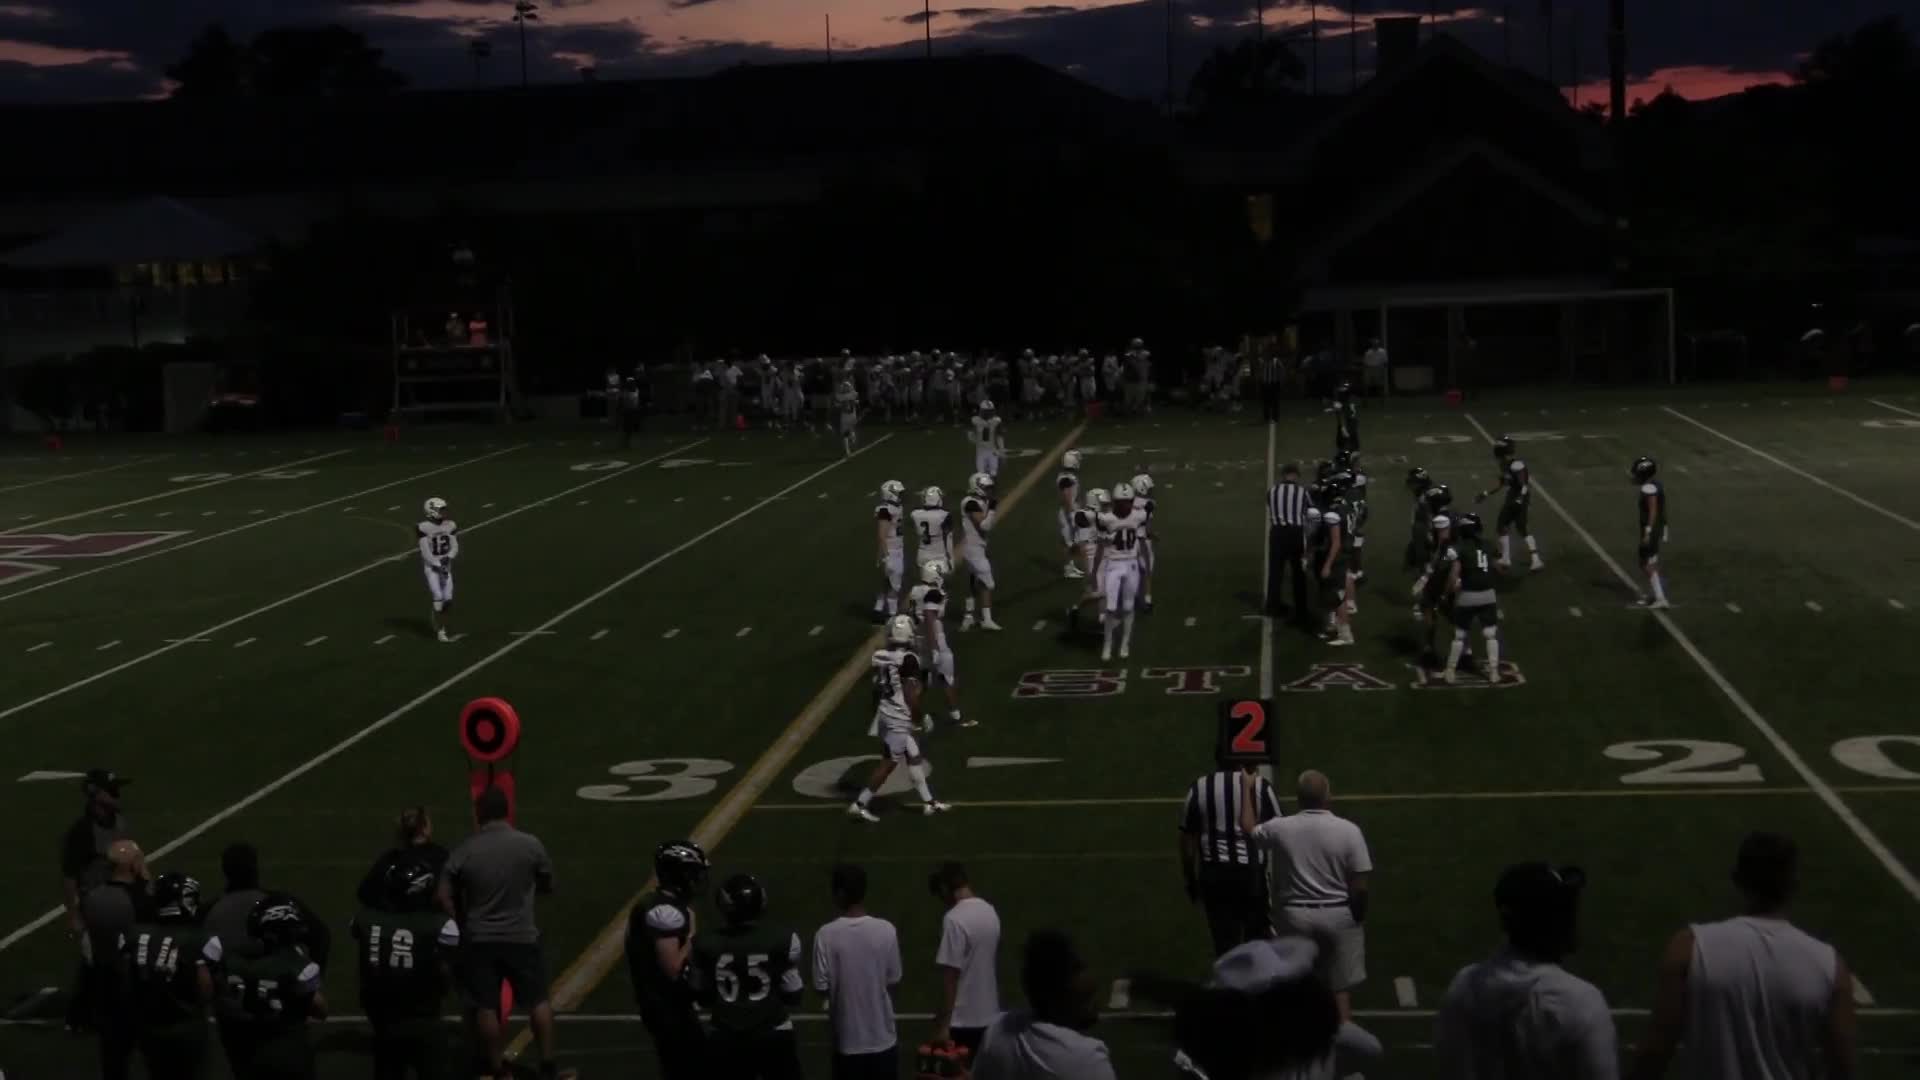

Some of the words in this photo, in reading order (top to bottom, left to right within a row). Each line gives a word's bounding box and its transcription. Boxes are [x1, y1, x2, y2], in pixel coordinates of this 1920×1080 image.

[432, 535, 450, 556] 12
[1476, 549, 1489, 573] 4
[1230, 700, 1266, 753] 2
[714, 952, 772, 1003] 65
